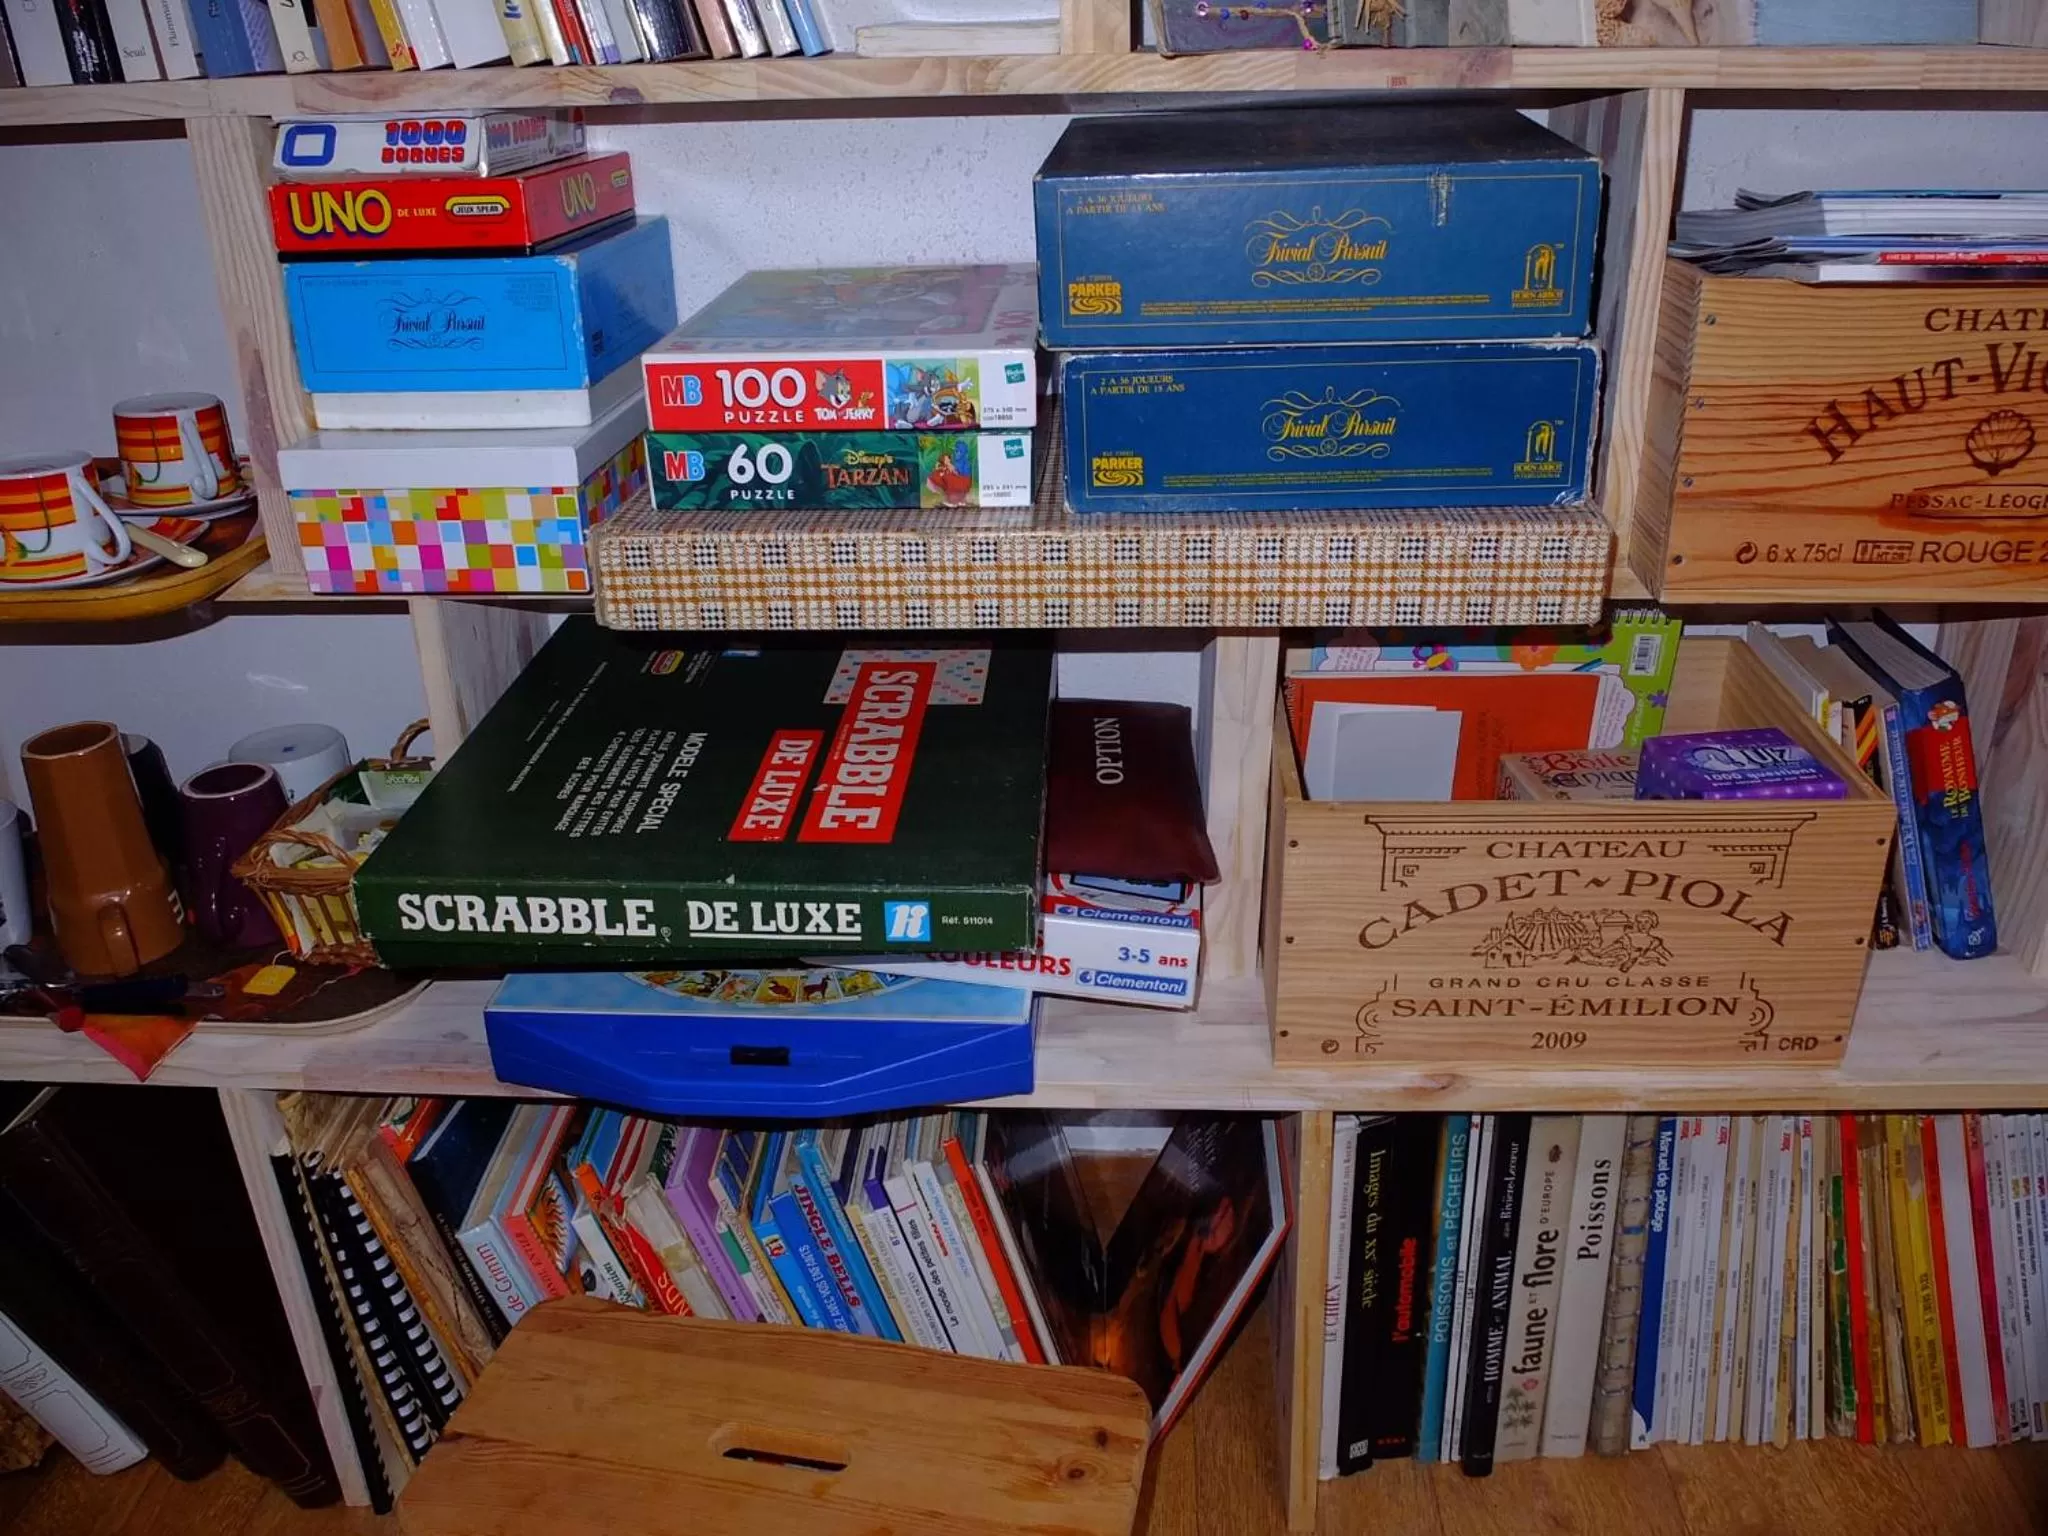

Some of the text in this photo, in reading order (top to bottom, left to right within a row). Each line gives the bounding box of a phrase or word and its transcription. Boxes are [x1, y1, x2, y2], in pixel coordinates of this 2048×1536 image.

[123, 46, 147, 59] Seuil
[385, 119, 467, 146] 1000
[381, 146, 465, 164] BORNES
[289, 188, 393, 235] UNO
[455, 203, 500, 215] JEUX SPEAR
[559, 172, 597, 218] UNO
[1262, 232, 1390, 264] Trivial Pursuit
[1068, 282, 1122, 297] PARKER
[391, 309, 486, 335] Trivial Pursuit
[660, 374, 703, 408] MB
[715, 367, 808, 409] 100
[1100, 386, 1134, 395] PARTIR
[1138, 385, 1150, 394] DE
[1166, 384, 1185, 393] ANS
[724, 411, 805, 424] PUZZLE
[814, 407, 877, 422] TOM JERRY
[1276, 407, 1398, 440] Trivial Pursuit
[664, 450, 706, 482] MB
[727, 442, 794, 485] 60
[821, 463, 912, 490] TARZAN
[1092, 457, 1144, 471] PARKER
[730, 488, 795, 501] PUZZLE
[1766, 542, 1844, 563] 6 x 75cl
[1919, 540, 2036, 563] ROUGE
[666, 732, 708, 777] MODELE
[816, 671, 920, 829] SCRABBLE
[1093, 717, 1125, 786] OPTION
[741, 739, 814, 829] DE LUXE
[1704, 771, 1742, 782] 1000
[1747, 767, 1818, 781] questions
[1939, 742, 1959, 808] ROYAUME
[605, 789, 627, 807] POUR
[633, 783, 683, 833] SPECIAL
[567, 807, 598, 837] LETTRES
[588, 810, 614, 835] EVITER
[1486, 840, 1688, 860] CHATEAU
[397, 893, 657, 937] SCRABBLE
[687, 901, 862, 935] DE LUXE
[1078, 906, 1192, 928] Clementoni
[1117, 945, 1189, 969] 3-5 ans
[1096, 970, 1185, 996] Clementoni
[1429, 976, 1711, 989] GRAND CRU CLASSE
[1391, 994, 1741, 1018] SAINT-ÉMILION
[1530, 1031, 1588, 1050] 2009
[1778, 1036, 1820, 1051] CRD
[1364, 1148, 1387, 1206] Images
[1444, 1133, 1467, 1234] PÊCHEURS
[1652, 1130, 1673, 1233] Manuel de pilotage
[1539, 1170, 1556, 1225] D'EUROPE
[1577, 1159, 1612, 1262] Poissons
[1365, 1212, 1383, 1230] du
[793, 1181, 834, 1252] JINGLE
[826, 1251, 862, 1310] BELLS
[1522, 1227, 1559, 1290] flore
[475, 1243, 526, 1315] de Grimm
[798, 1244, 841, 1319] AVEC VOS ENFANTS
[905, 1218, 960, 1327] Le monde des petites filles
[1362, 1266, 1378, 1309] siècle
[1491, 1249, 1513, 1311] ANIMAL
[1324, 1284, 1342, 1329] CHIEN
[1392, 1236, 1417, 1344] l'automobile
[1435, 1258, 1457, 1344] POISSONS
[1484, 1325, 1504, 1381] HOMME
[1511, 1305, 1549, 1377] faune
